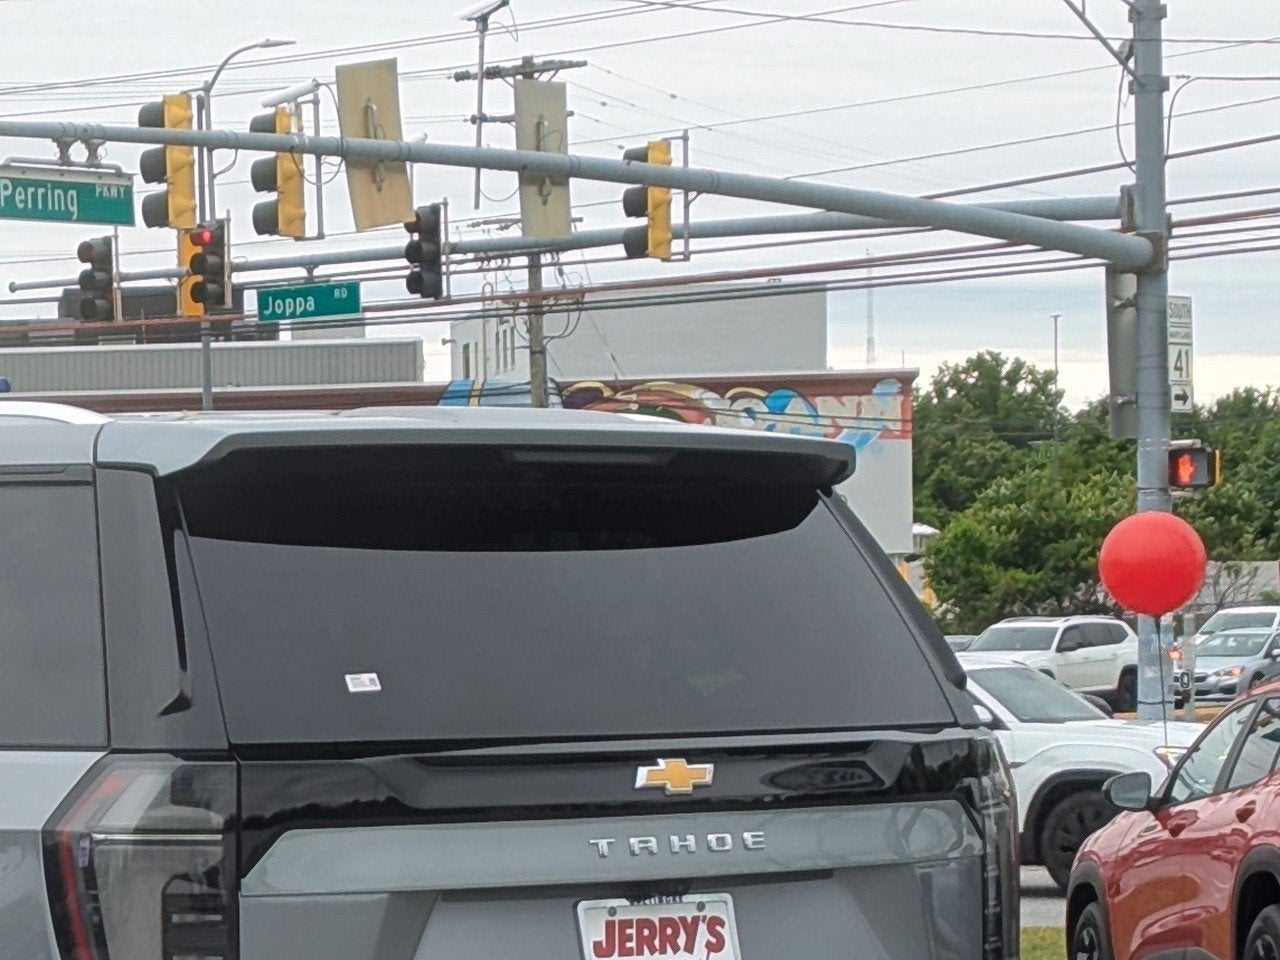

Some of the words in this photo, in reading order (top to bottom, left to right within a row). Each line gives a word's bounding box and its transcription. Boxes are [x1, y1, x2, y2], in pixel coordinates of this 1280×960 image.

[0, 178, 78, 220] Perring
[95, 184, 126, 198] PKWY
[263, 296, 316, 317] Joppa
[333, 287, 348, 299] RD
[1173, 348, 1189, 379] 41
[589, 831, 766, 858] TAHOE
[592, 914, 726, 959] JERRY'S
